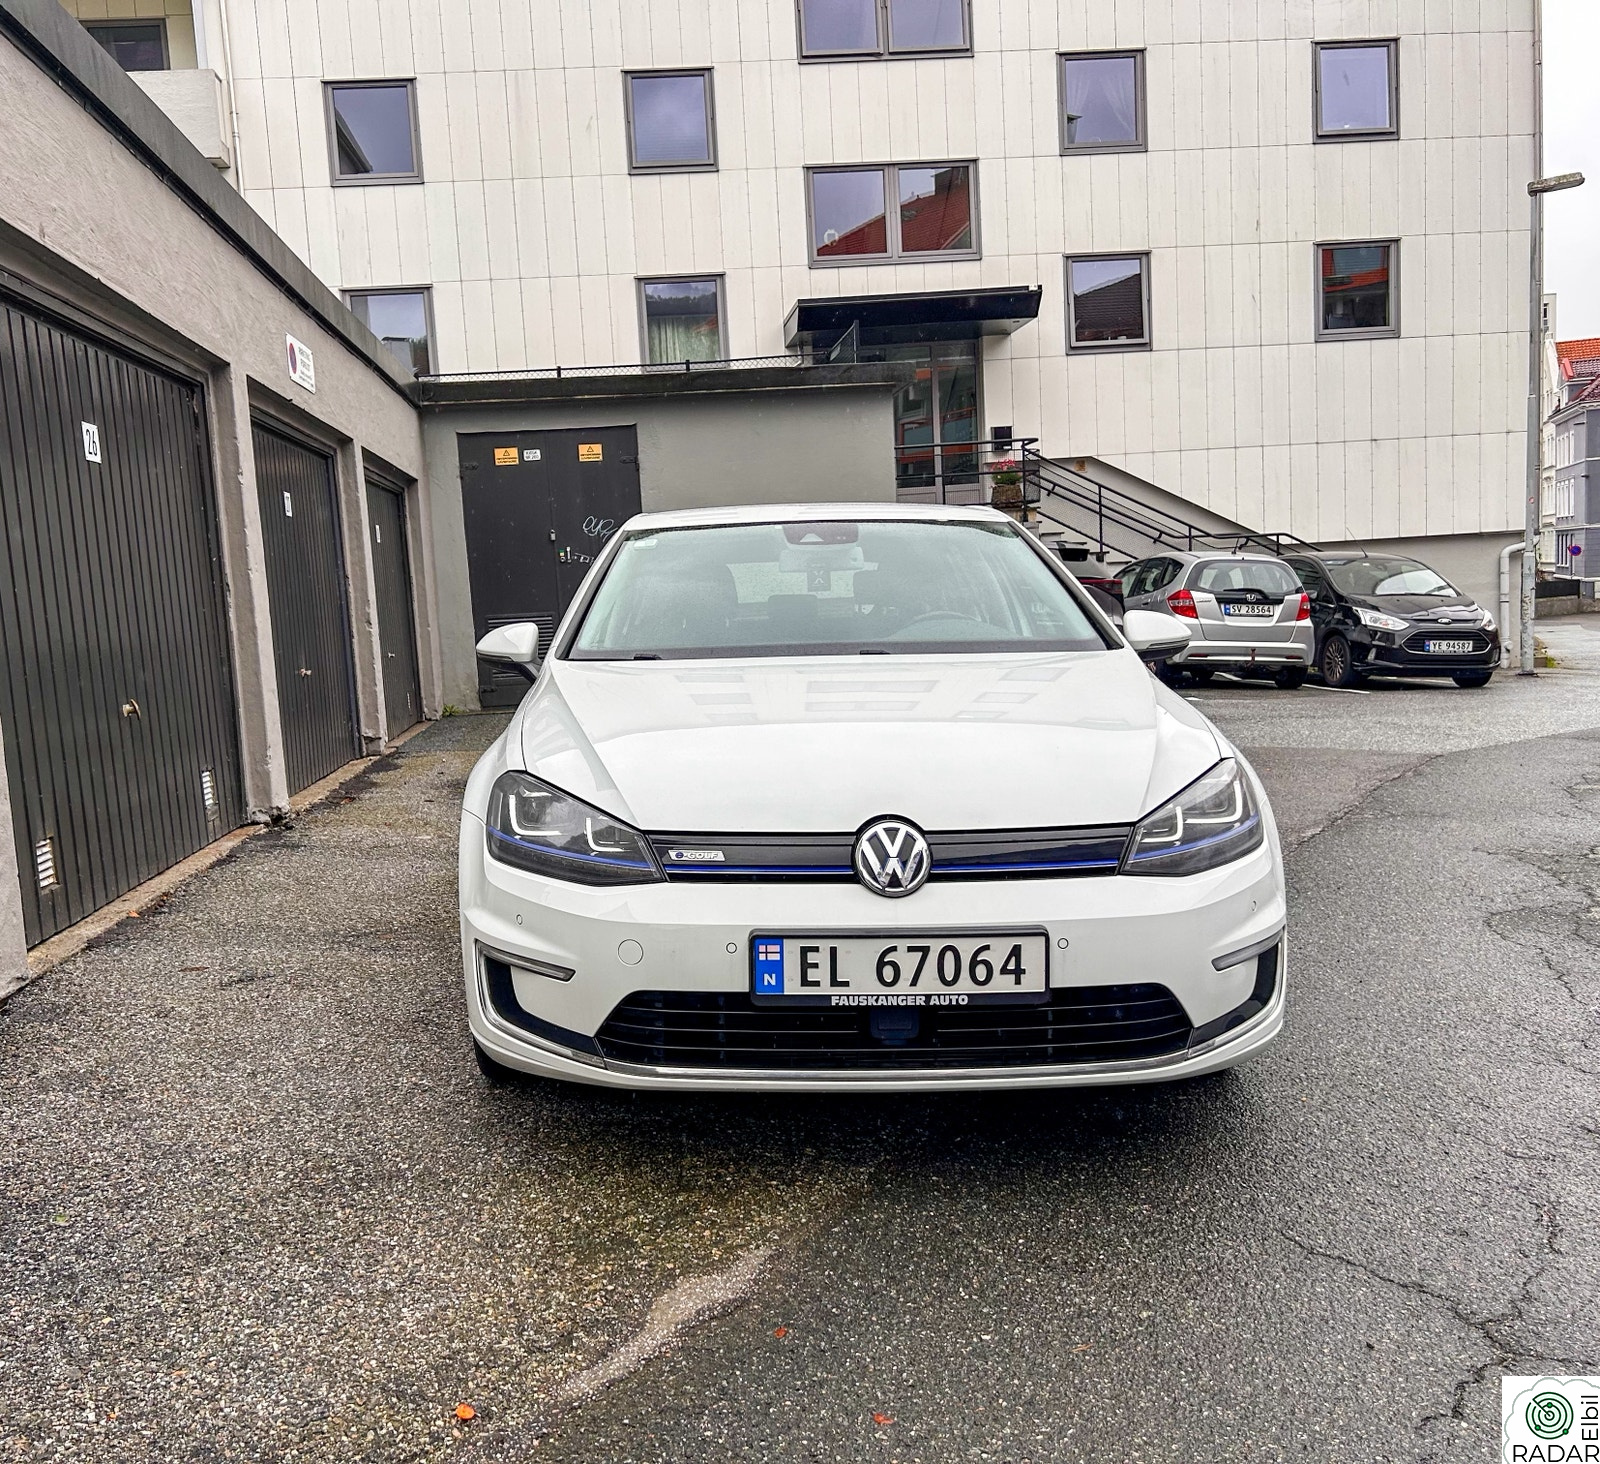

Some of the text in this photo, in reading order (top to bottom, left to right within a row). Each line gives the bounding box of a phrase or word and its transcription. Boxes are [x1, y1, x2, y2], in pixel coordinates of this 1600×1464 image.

[86, 428, 97, 456] 26
[1231, 605, 1271, 613] SV 28564
[1445, 642, 1471, 650] 94587
[799, 943, 1027, 988] EL 67064
[763, 973, 776, 986] N
[831, 995, 969, 1006] FAUSKANGER AUTO
